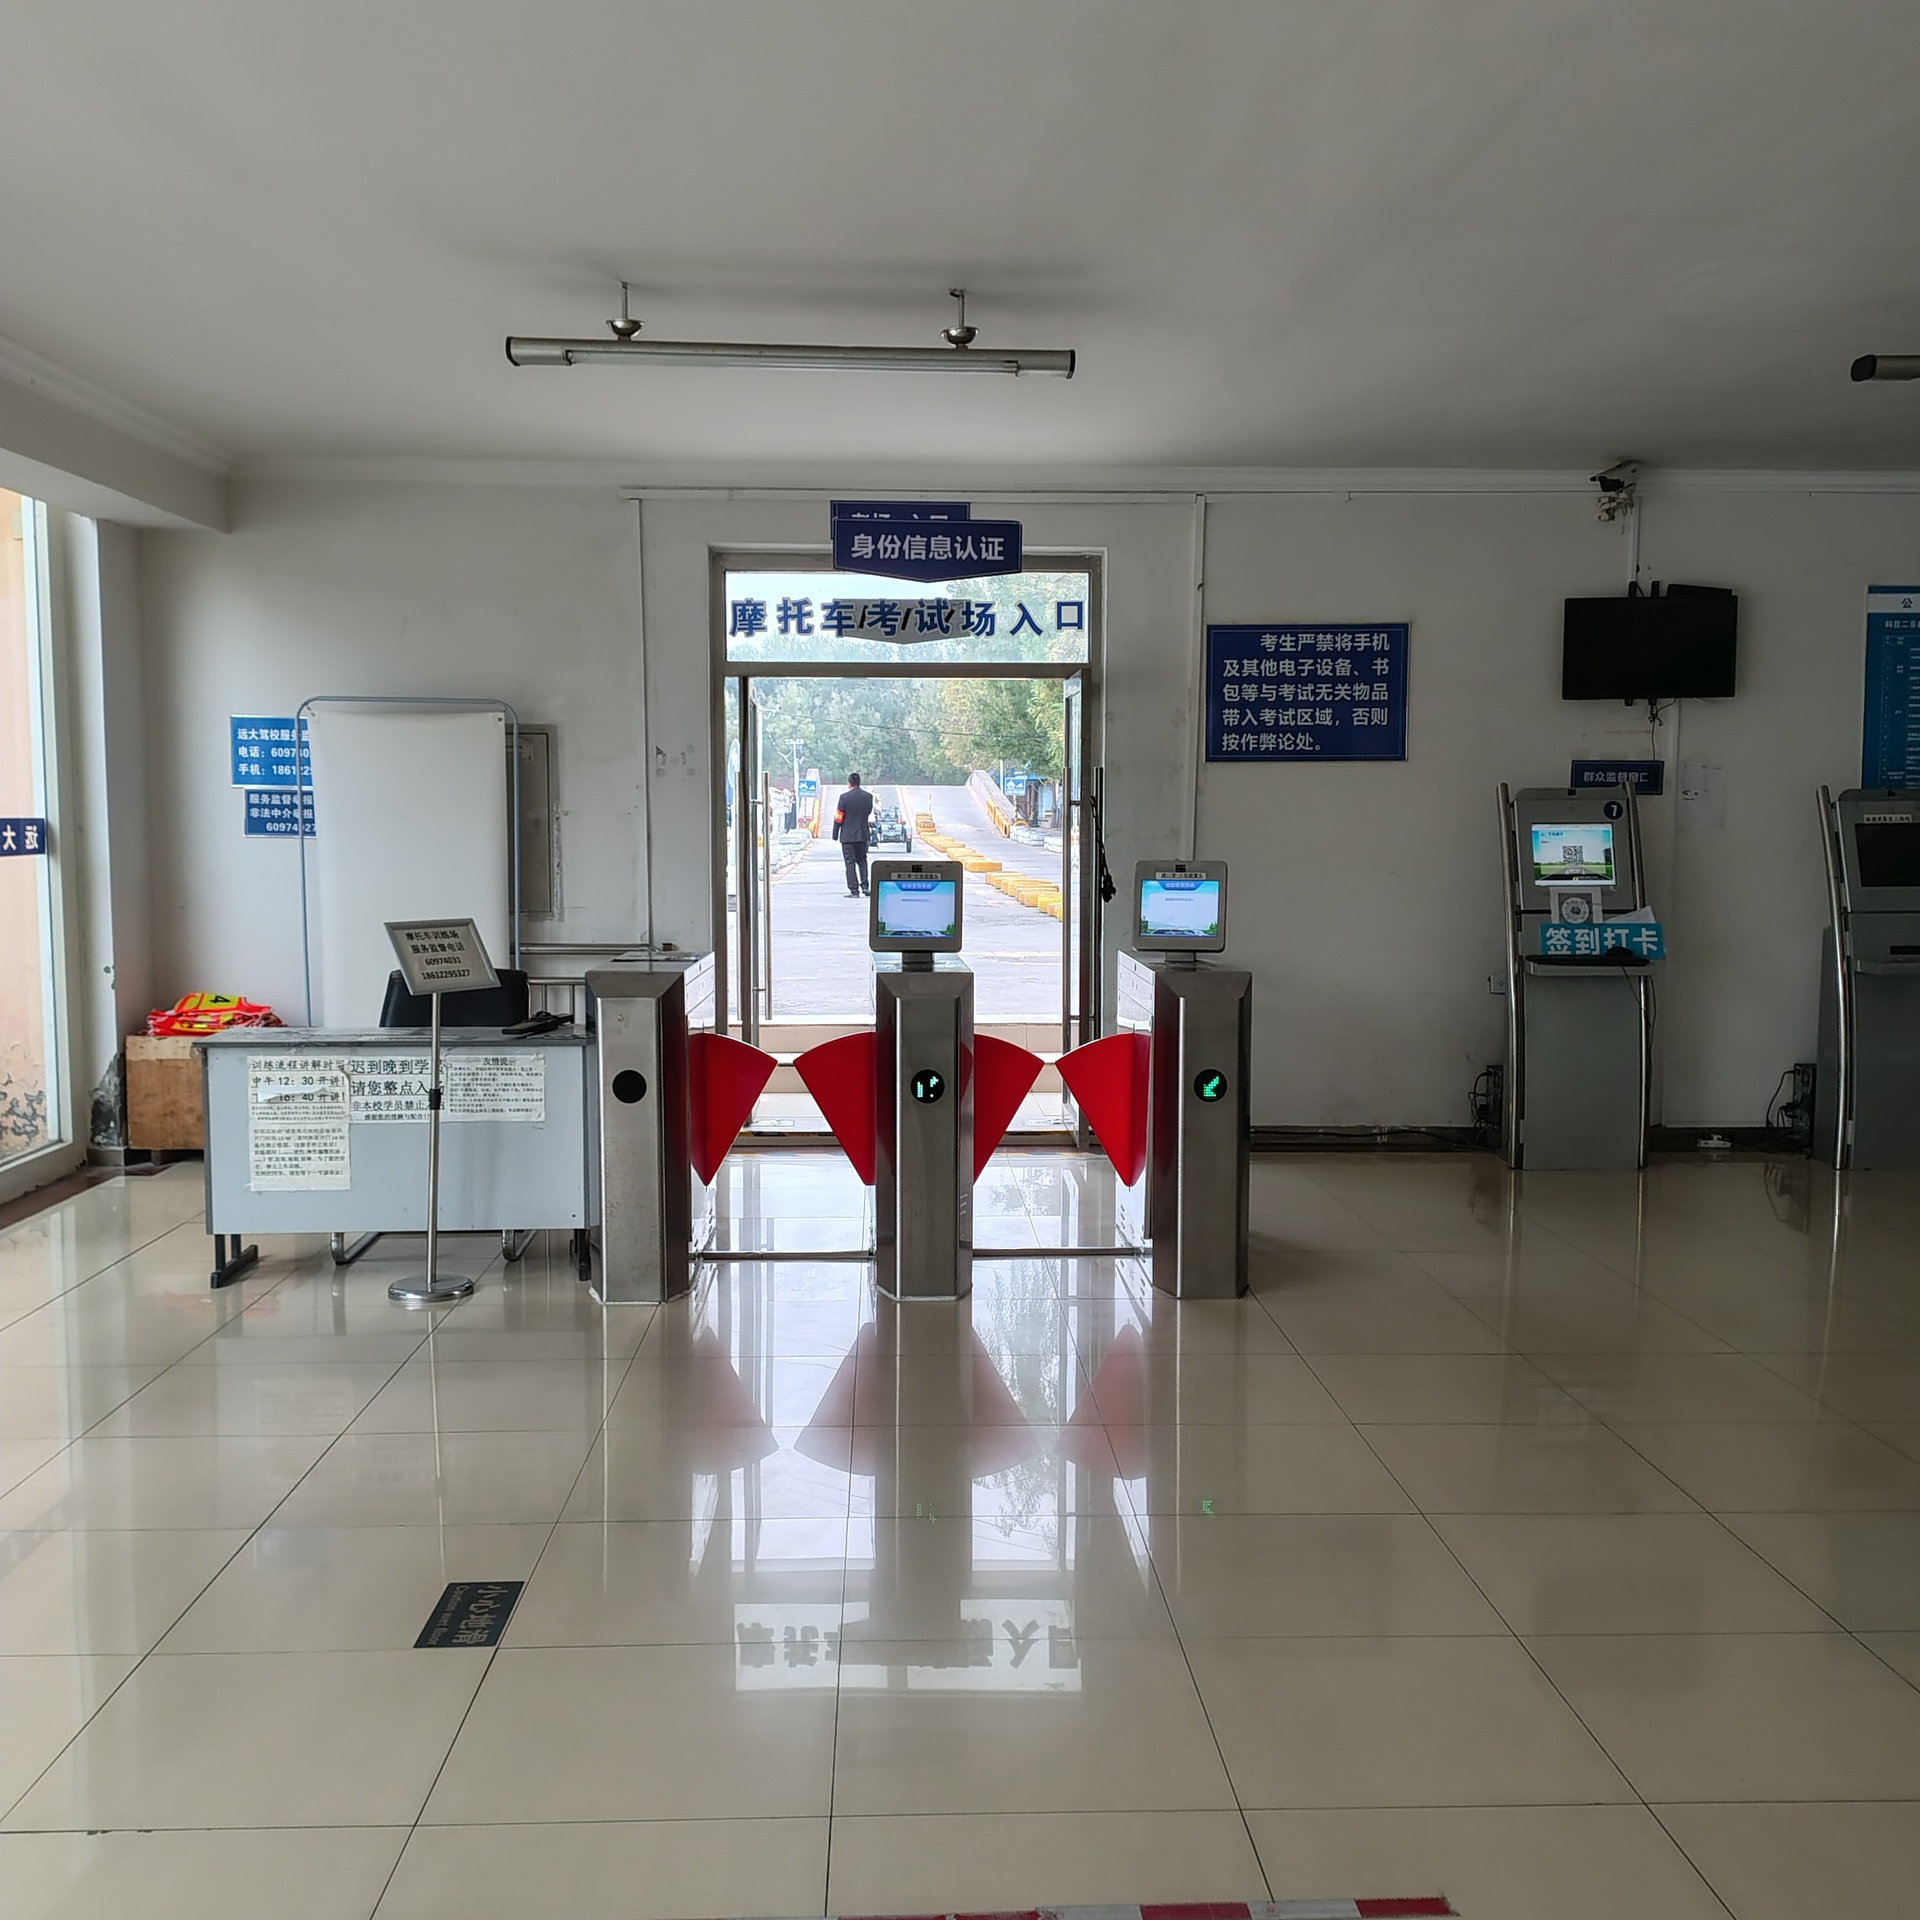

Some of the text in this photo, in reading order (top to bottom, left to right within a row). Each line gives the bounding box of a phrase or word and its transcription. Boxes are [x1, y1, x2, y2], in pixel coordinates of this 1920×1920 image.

[850, 533, 1005, 561] 身份信息认证
[728, 597, 1085, 638] 摩托车考试场入口
[1259, 632, 1390, 652] 考生严禁将手机
[1222, 658, 1389, 677] 及其他电子设备、书
[1222, 683, 1389, 702] 包等与考试无关物品
[1222, 707, 1388, 727] 带入考试区域，否则
[1221, 732, 1323, 752] 按作弊论处。
[1609, 804, 1618, 817] 7
[266, 822, 316, 832] 6097427
[411, 942, 465, 954] 服务监督电话
[1545, 927, 1659, 956] 签到打卡
[425, 956, 462, 966] 60974031
[421, 969, 470, 980] 18612295327
[451, 1585, 509, 1644] 小心地滑
